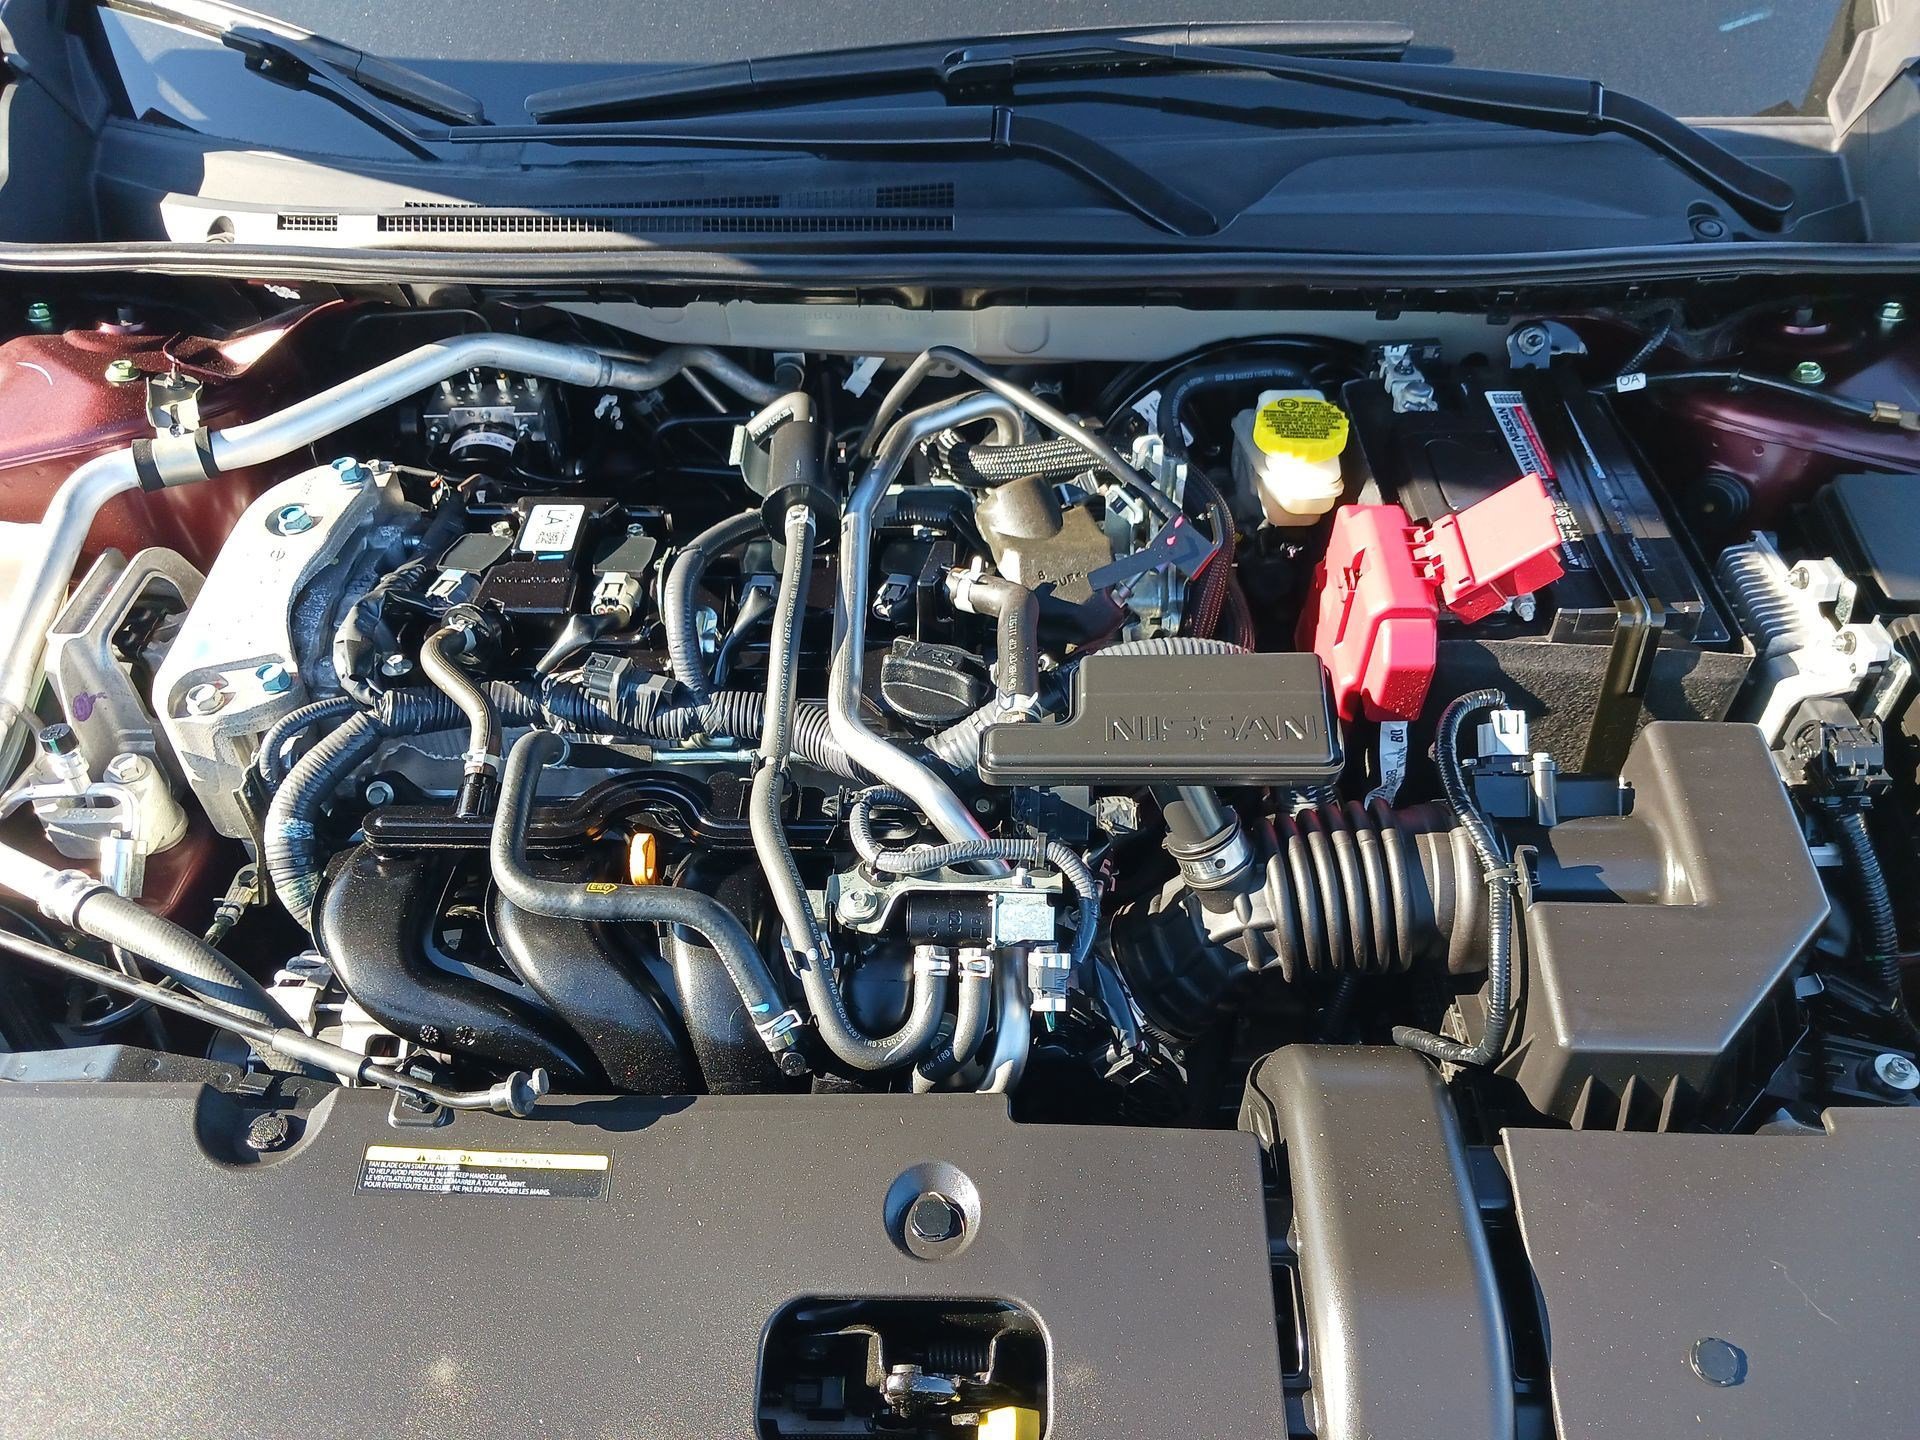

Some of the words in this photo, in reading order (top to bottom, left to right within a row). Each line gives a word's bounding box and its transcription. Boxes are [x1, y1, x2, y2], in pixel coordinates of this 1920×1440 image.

[1619, 374, 1641, 386] OA
[1104, 714, 1318, 741] NISSAN
[374, 1174, 413, 1182] VENTILATEUR
[413, 1176, 435, 1184] RISQUE
[408, 1169, 436, 1177] PERSONAL
[363, 1180, 381, 1188] POUR
[402, 1182, 422, 1190] TOUTE
[461, 1185, 473, 1193] PAS
[482, 1186, 519, 1195] APPROCHER
